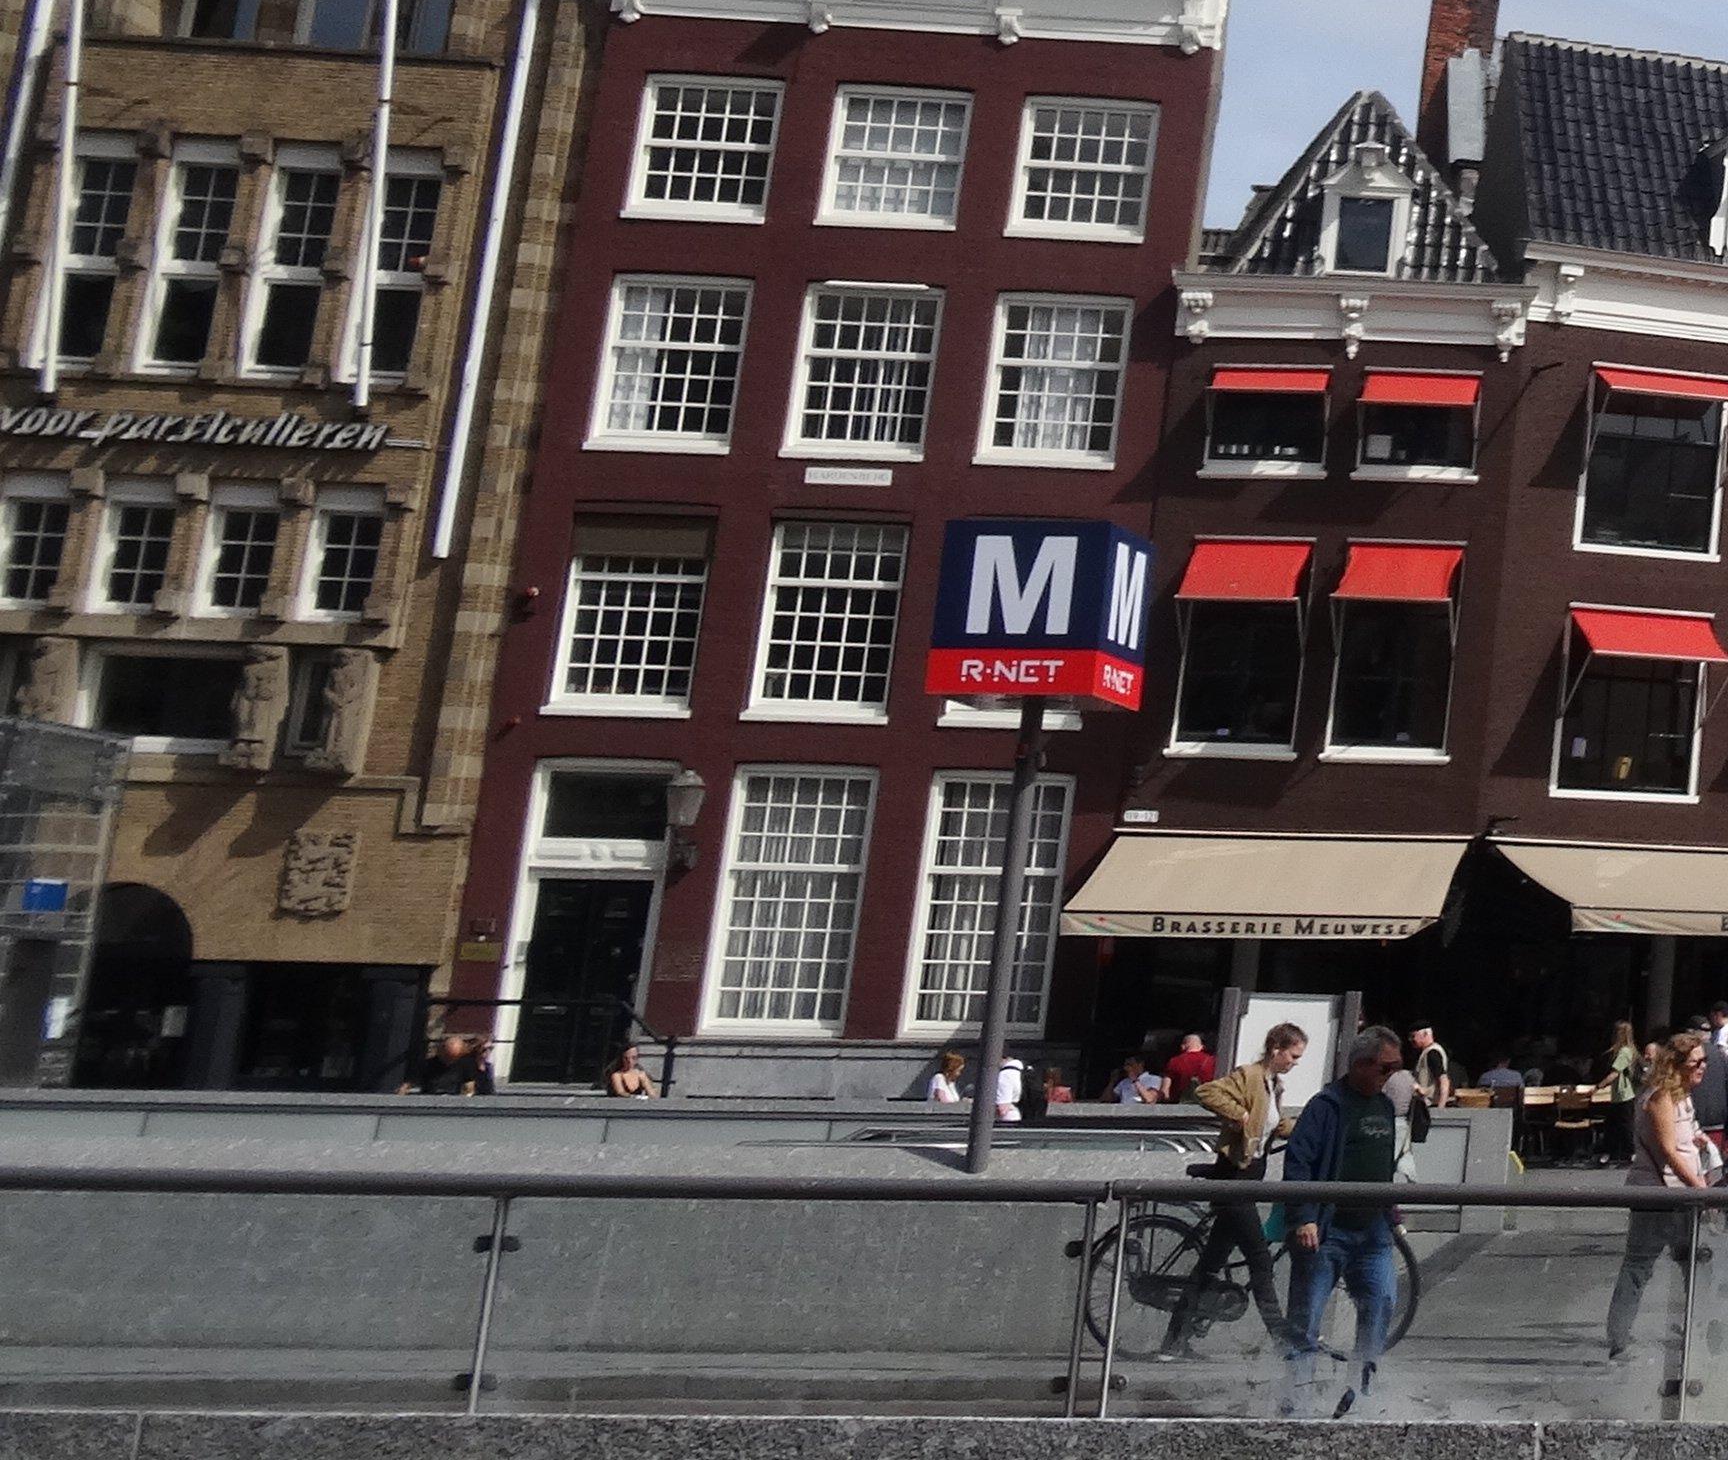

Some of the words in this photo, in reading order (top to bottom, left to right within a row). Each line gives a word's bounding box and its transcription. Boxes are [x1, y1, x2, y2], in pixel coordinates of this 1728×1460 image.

[0, 406, 96, 436] voor
[965, 535, 1079, 635] M
[1107, 541, 1148, 651] M
